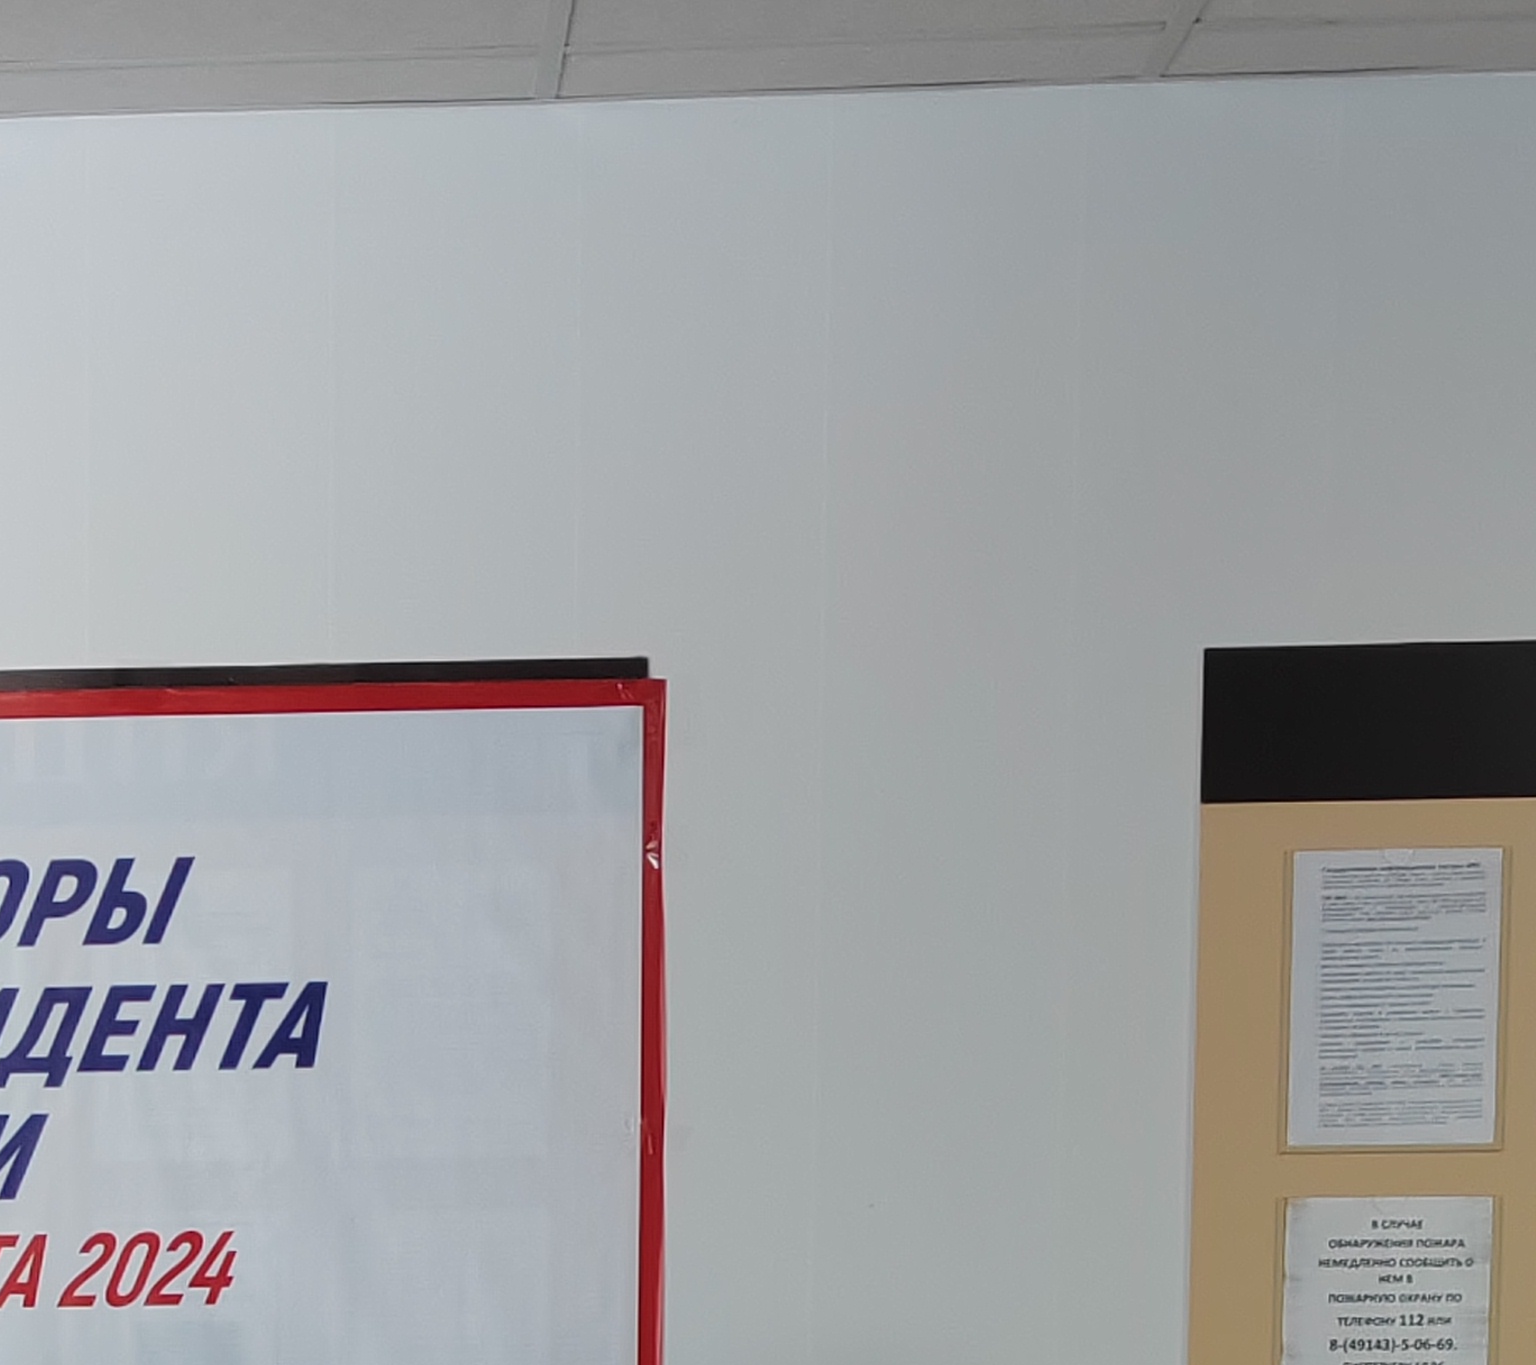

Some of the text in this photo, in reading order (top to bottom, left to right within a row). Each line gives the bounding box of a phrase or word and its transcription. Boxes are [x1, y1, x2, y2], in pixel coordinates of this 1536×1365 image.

[1371, 1219, 1424, 1229] В СЛУЧАЕ
[57, 1230, 237, 1308] 2024
[1399, 1314, 1424, 1327] 112
